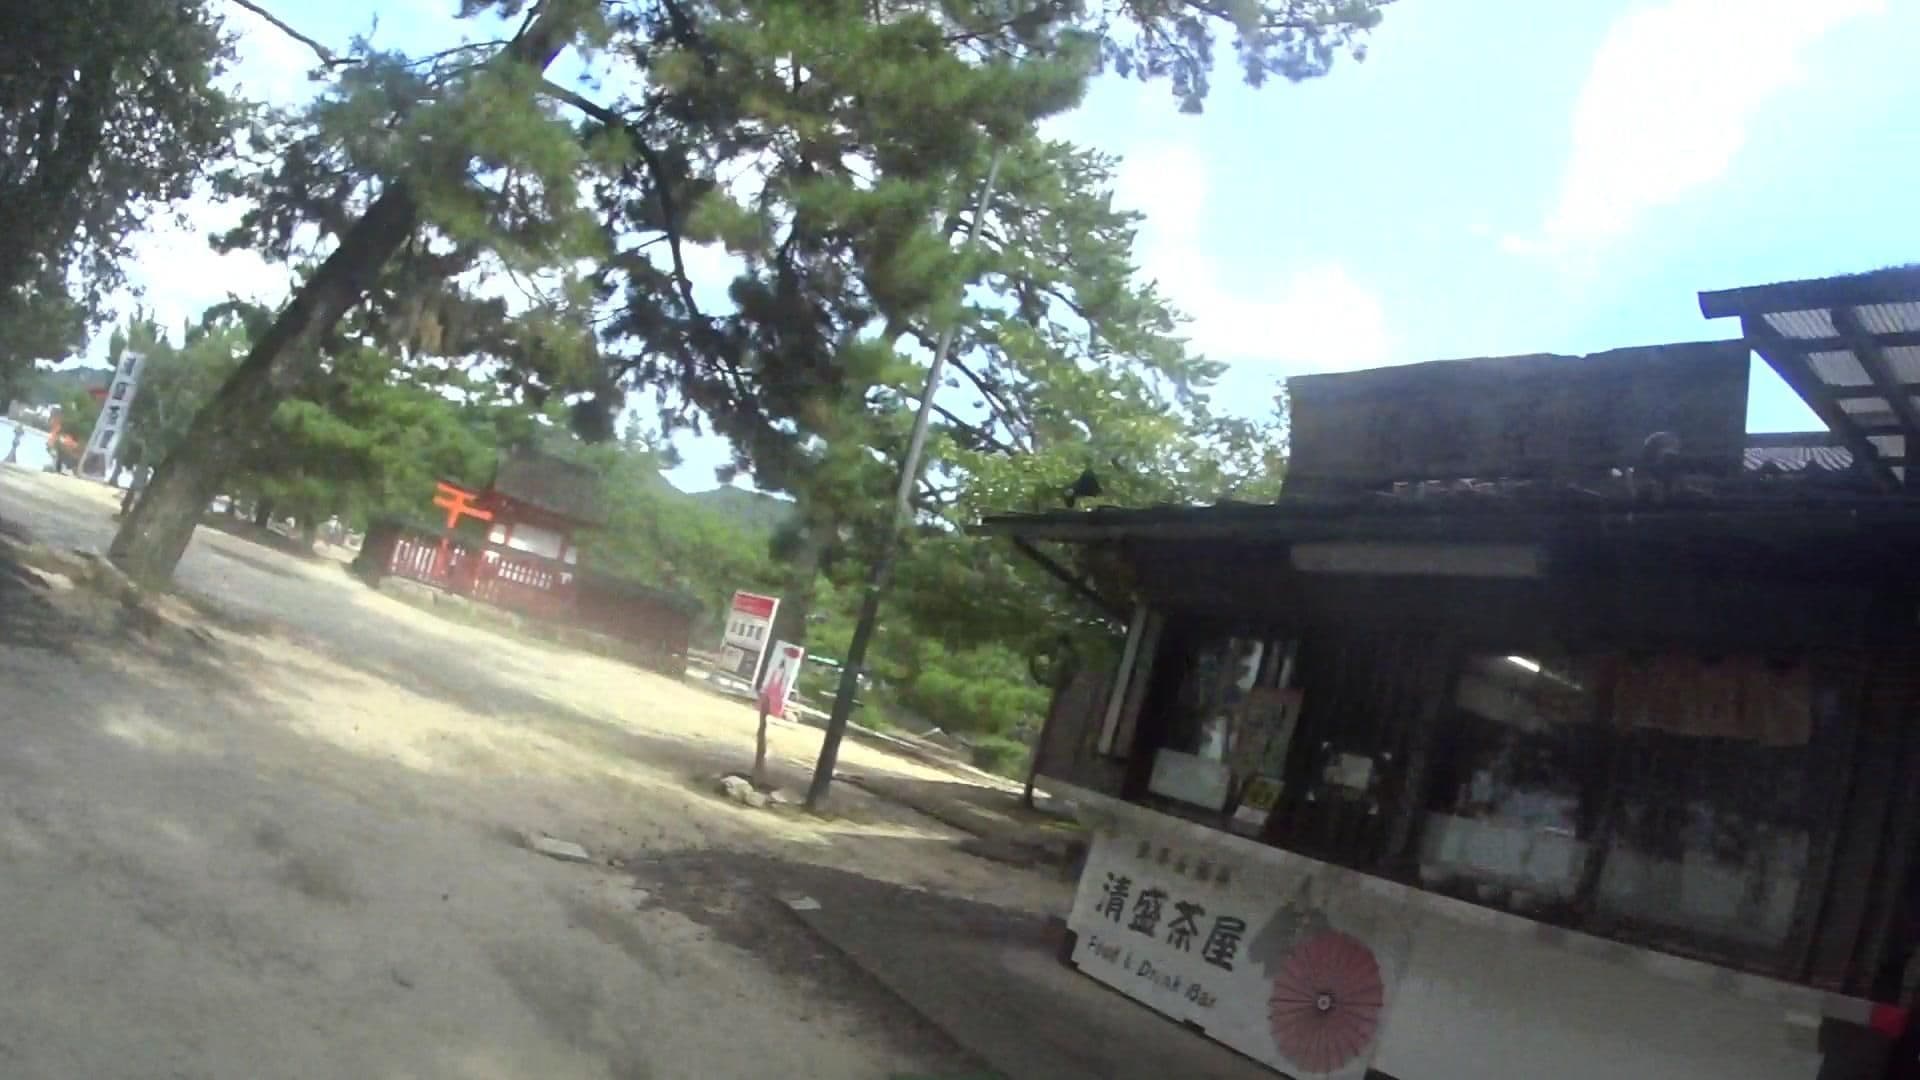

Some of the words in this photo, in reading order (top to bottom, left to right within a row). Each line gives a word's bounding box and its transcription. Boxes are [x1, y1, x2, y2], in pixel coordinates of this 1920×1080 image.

[1095, 872, 1247, 971] 清盛茶屋
[1184, 983, 1217, 1008] Bar
